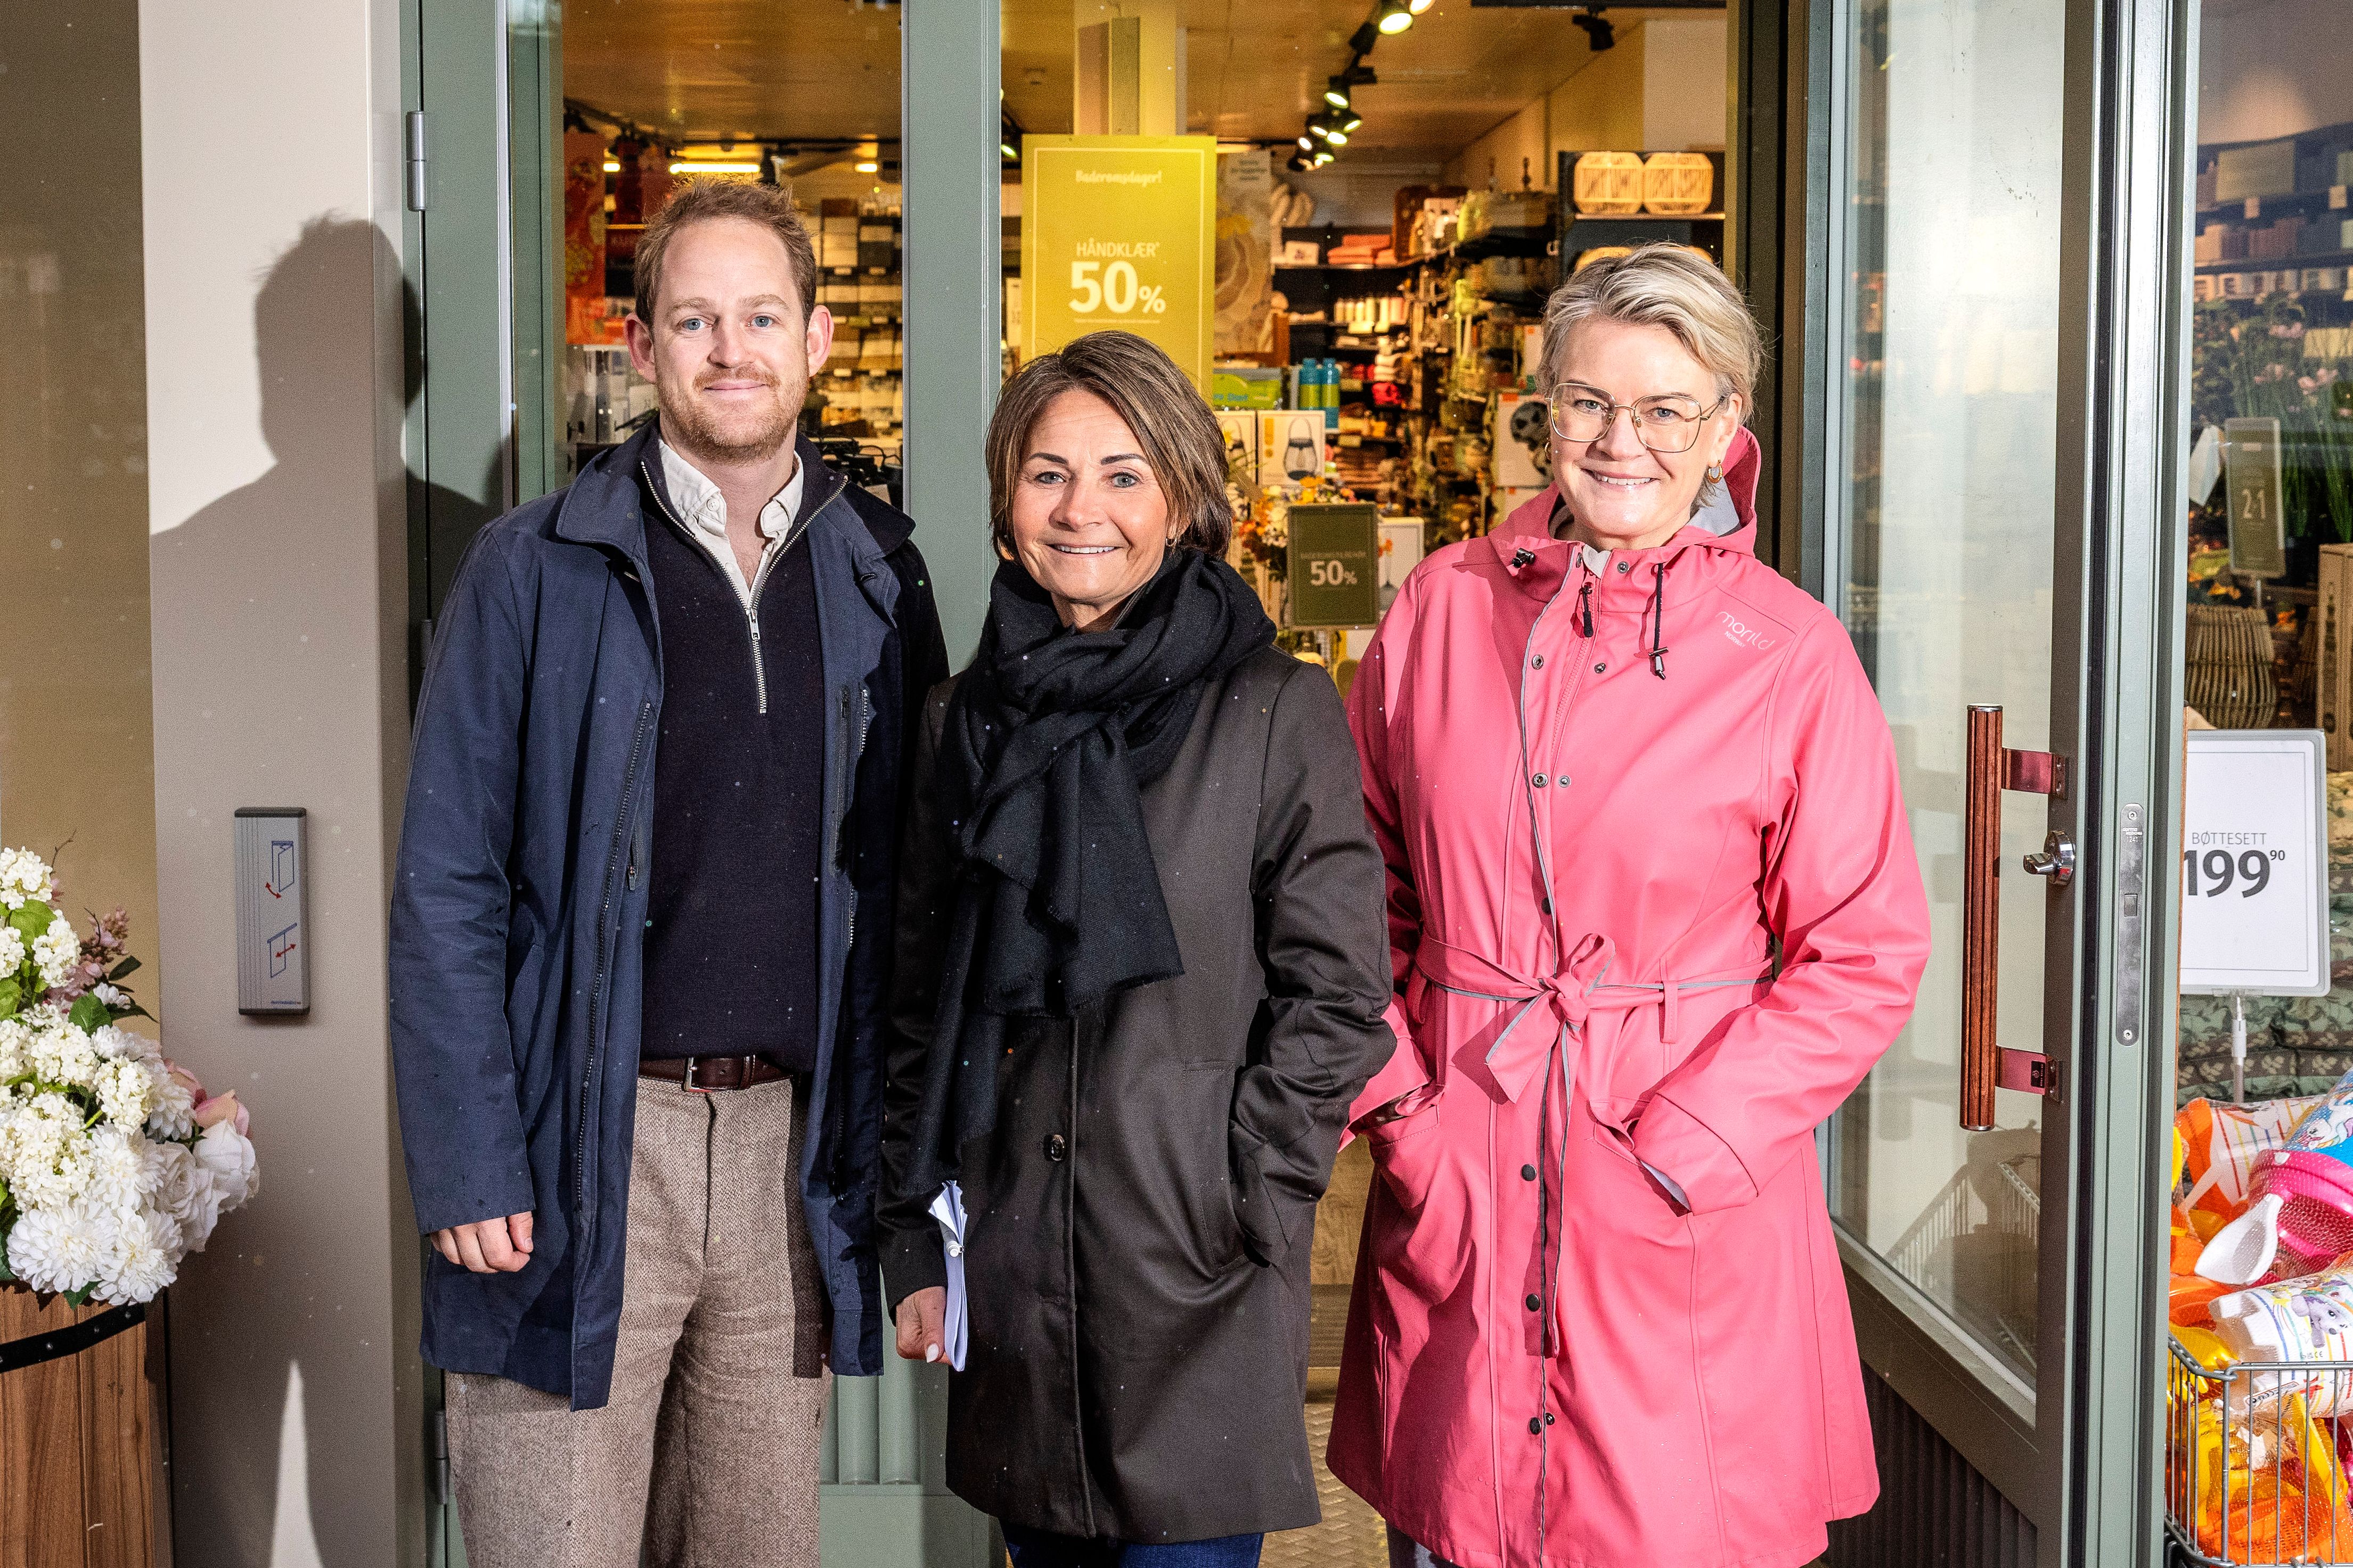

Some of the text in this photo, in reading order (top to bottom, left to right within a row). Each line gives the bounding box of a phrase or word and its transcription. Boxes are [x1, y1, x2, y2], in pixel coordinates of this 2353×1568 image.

[1068, 260, 1166, 314] 50%
[1310, 560, 1358, 586] 50%
[1715, 611, 1776, 650] norild
[1725, 631, 1746, 648] NORWAY
[2192, 831, 2267, 845] BØTTESETT
[2184, 850, 2285, 898] 199 90
